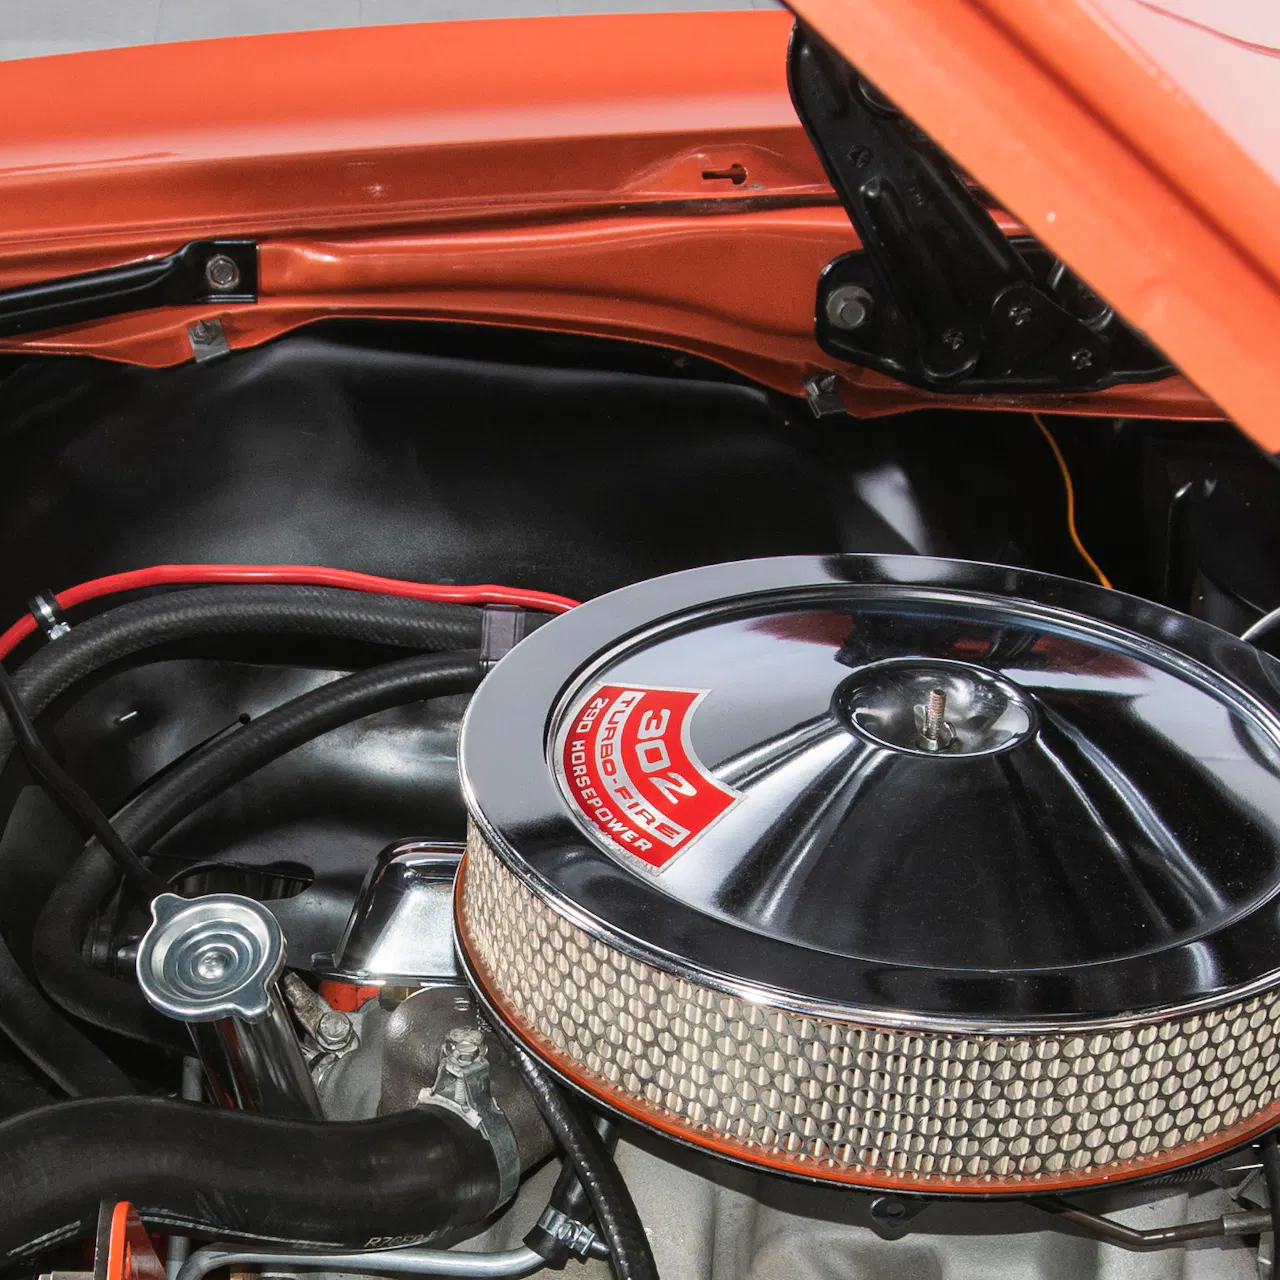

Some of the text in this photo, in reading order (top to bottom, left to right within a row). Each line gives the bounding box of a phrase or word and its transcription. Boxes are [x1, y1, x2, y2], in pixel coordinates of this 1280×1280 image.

[576, 697, 609, 733] 290
[635, 708, 699, 804] 302
[571, 741, 653, 852] HORSEPOWER
